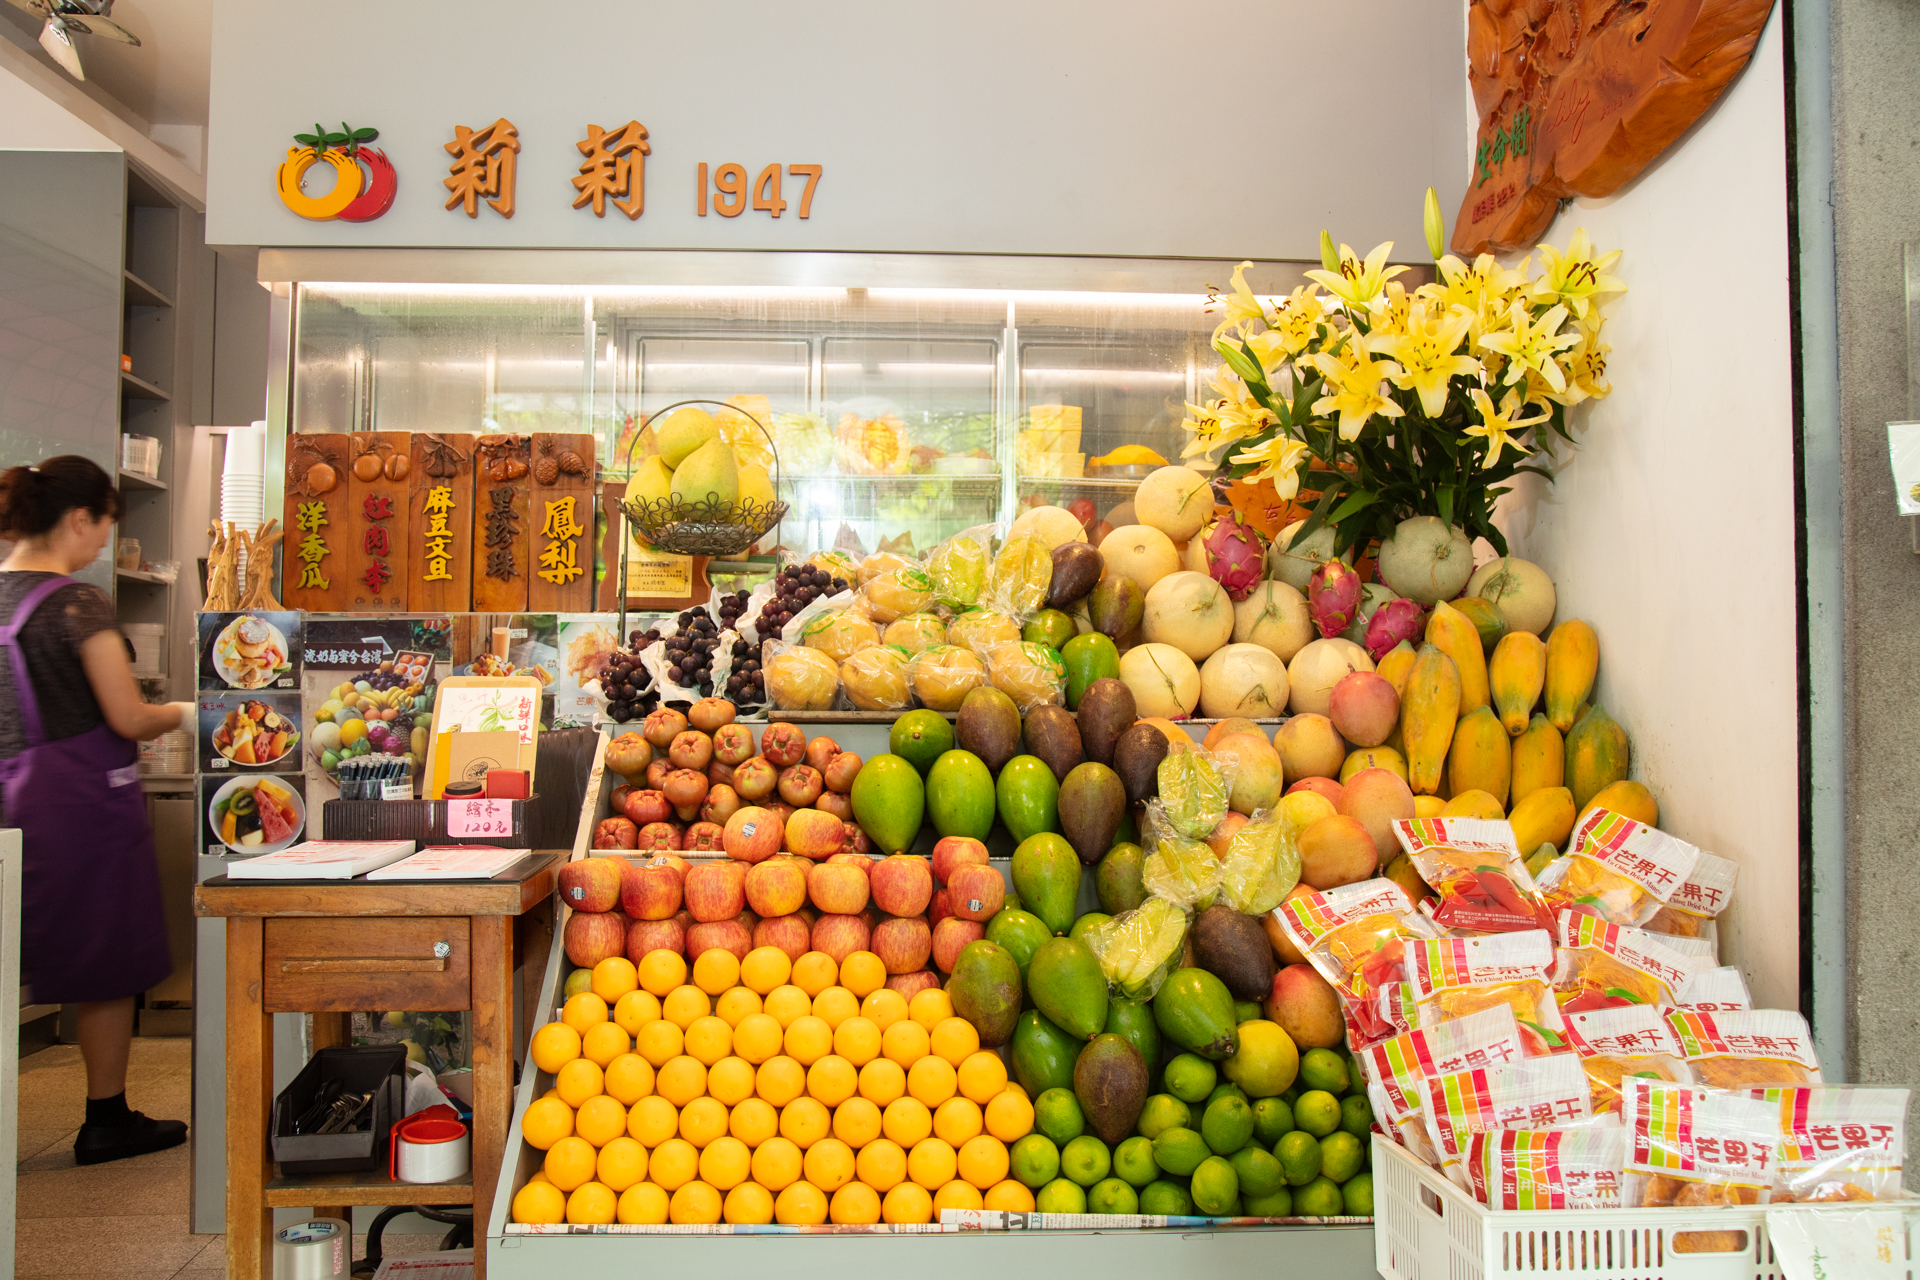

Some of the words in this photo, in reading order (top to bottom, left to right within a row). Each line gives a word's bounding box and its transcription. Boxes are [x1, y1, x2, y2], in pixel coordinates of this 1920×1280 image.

[1476, 104, 1531, 189] 生命樹
[443, 117, 652, 221] 莉莉
[697, 162, 823, 220] 1947
[296, 501, 332, 591] 洋香瓜
[423, 486, 456, 582] 麻豆文旦
[484, 486, 520, 582] 黑珍珠
[537, 496, 584, 586] 鳳梨
[576, 697, 595, 705] 芒果
[1613, 849, 1678, 887] 芒果干
[1629, 870, 1645, 882] Dried
[1618, 945, 1686, 983] 芒果干
[1589, 1029, 1664, 1049] 芒果干
[1724, 1034, 1801, 1051] 芒果干
[1500, 1097, 1583, 1130] 芒果干
[1695, 1137, 1772, 1170] 芒果干
[1810, 1124, 1894, 1151] 芒果干
[1566, 1170, 1623, 1199] 芒果
